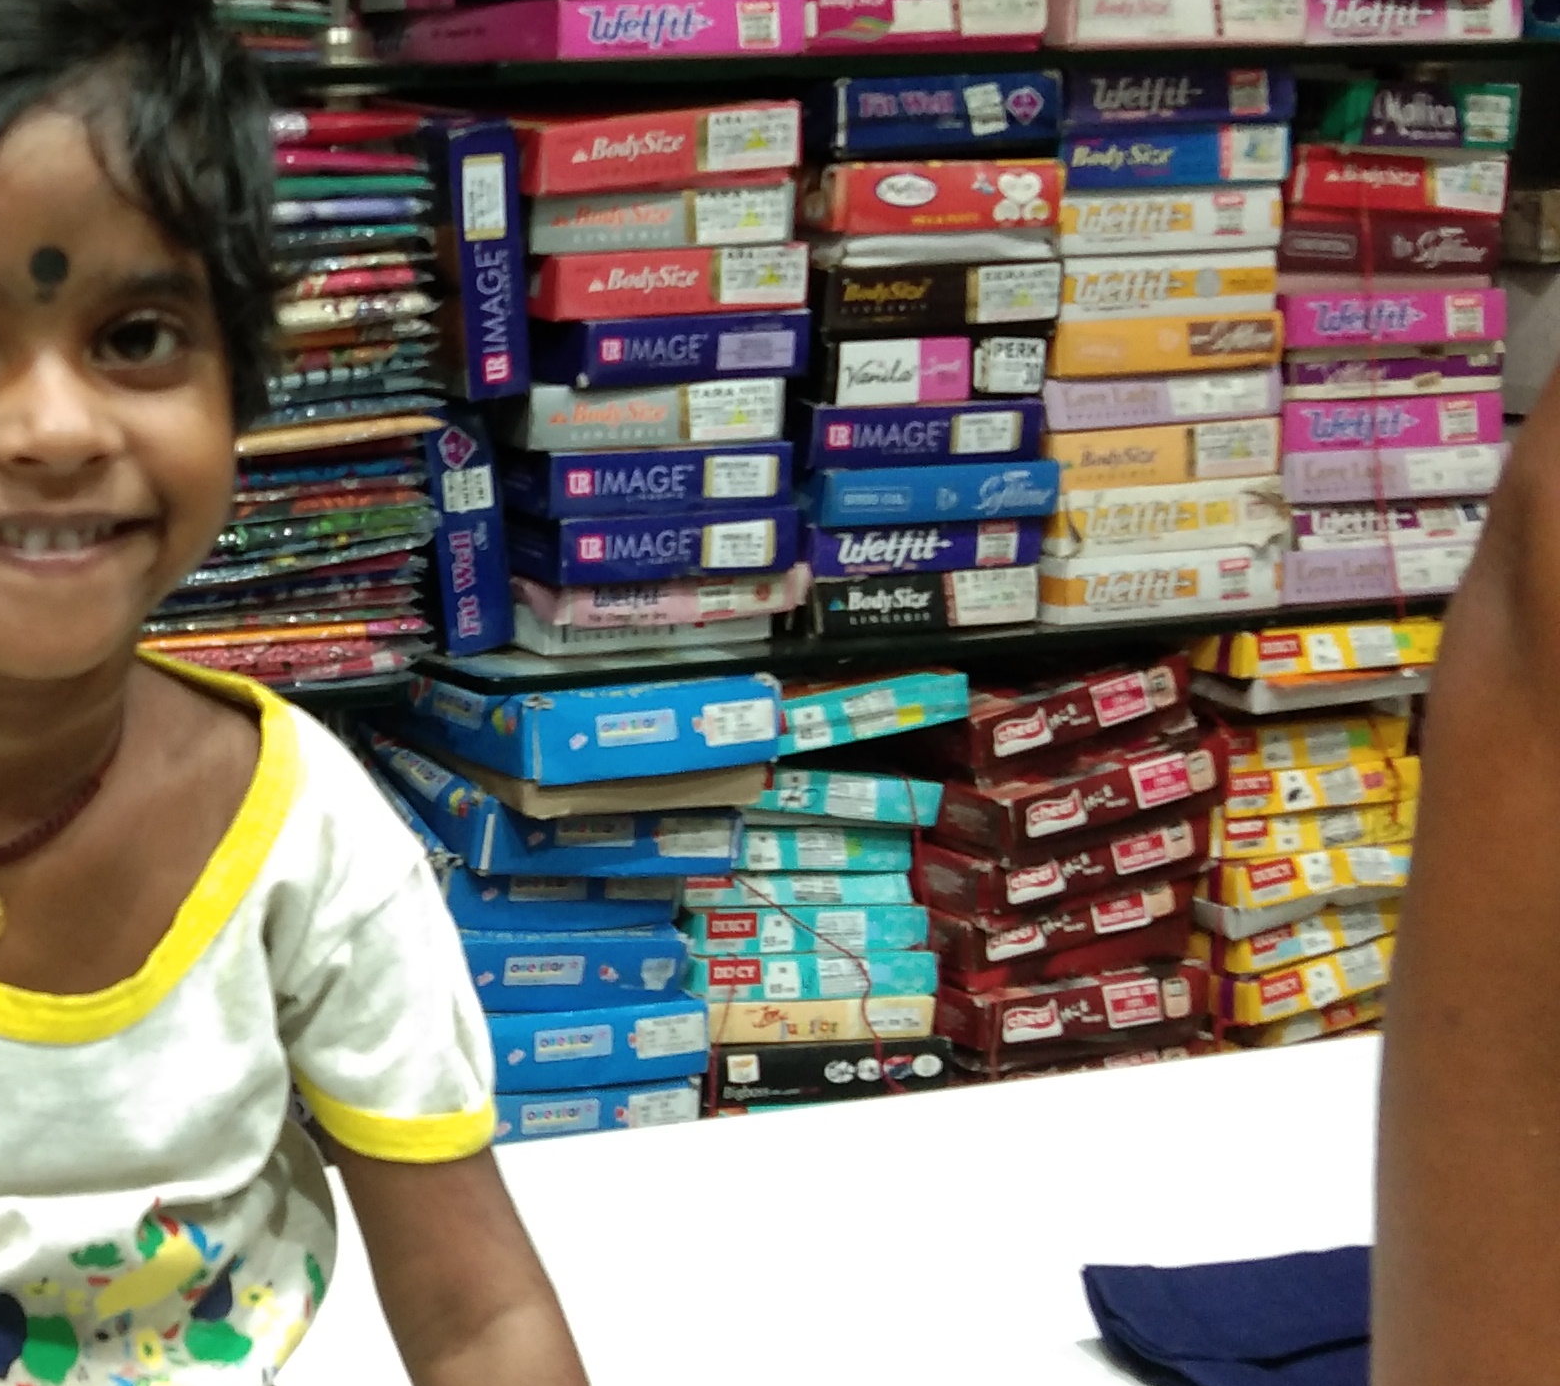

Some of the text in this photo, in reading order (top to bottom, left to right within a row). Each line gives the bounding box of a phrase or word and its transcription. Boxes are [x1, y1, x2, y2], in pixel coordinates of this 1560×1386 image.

[580, 3, 714, 48] Welfit
[1090, 76, 1205, 112] Welfit
[474, 243, 510, 353] IMAGE
[623, 332, 709, 363] IMAGE
[852, 419, 951, 450] IMAGE
[593, 464, 696, 499] IMAGE
[604, 528, 703, 561] IMAGE
[836, 528, 954, 568] Welfit
